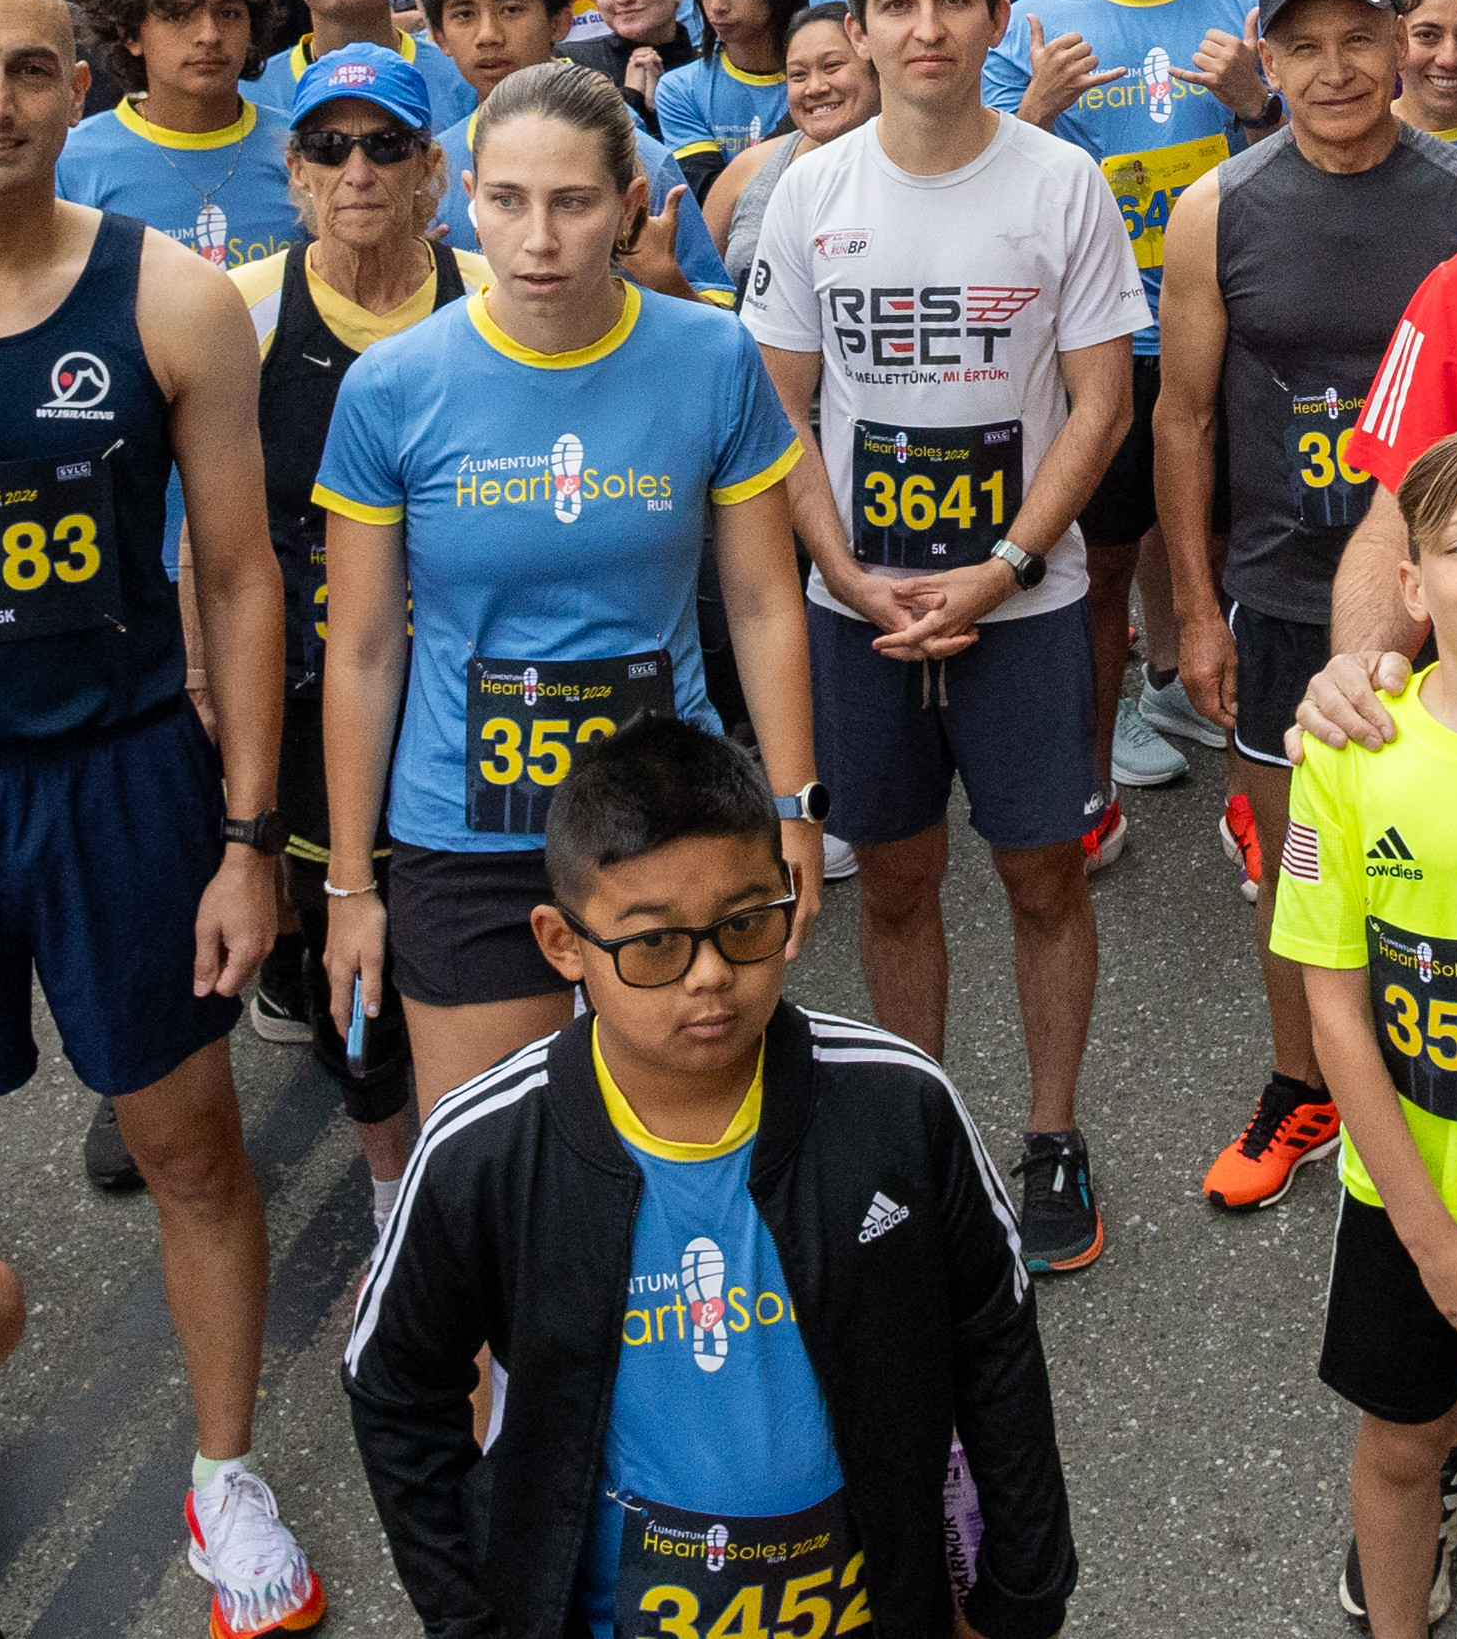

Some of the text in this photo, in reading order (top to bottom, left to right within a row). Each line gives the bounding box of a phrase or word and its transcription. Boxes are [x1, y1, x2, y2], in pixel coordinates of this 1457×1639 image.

[338, 65, 367, 75] RUN
[328, 74, 376, 86] HAPPY
[830, 286, 962, 324] RES
[836, 326, 1012, 367] PECT
[944, 370, 960, 383] MI
[36, 407, 115, 421] WVJSRACING
[1292, 401, 1327, 415] Heart
[864, 440, 970, 461] Heart Soles 2026
[59, 464, 89, 477] SVLG
[469, 455, 549, 473] LUMENTUM
[4, 488, 38, 506] 2026
[456, 473, 552, 508] Heart
[582, 468, 673, 501] Soles
[647, 499, 674, 512] RUN
[863, 469, 1005, 532] 3641
[930, 543, 947, 556] 5K
[481, 679, 612, 700] Heart Soles 2026
[1366, 863, 1424, 881] owdies
[1379, 942, 1419, 970] Heart
[858, 1205, 910, 1243] adidas
[652, 1524, 706, 1541] LUMENTUM
[643, 1531, 831, 1561] Heart Soles 2026
[639, 1550, 873, 1639] 3452
